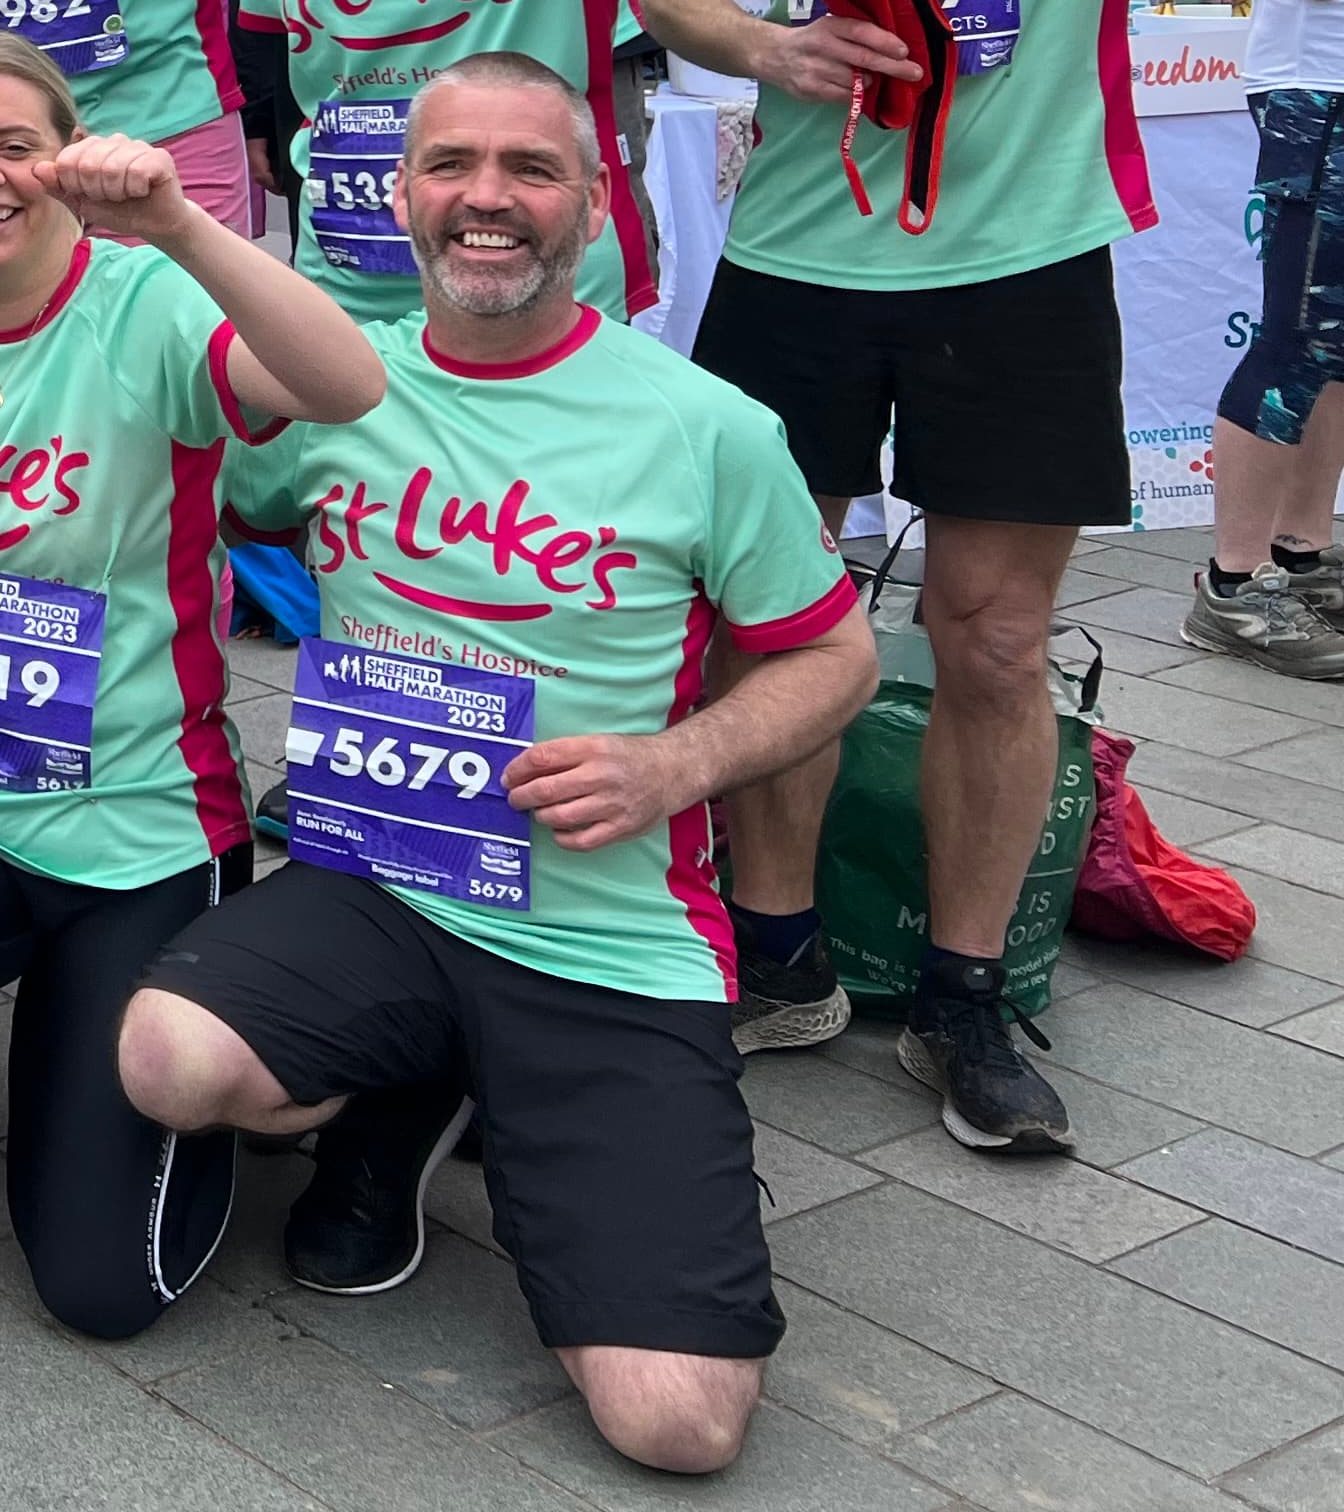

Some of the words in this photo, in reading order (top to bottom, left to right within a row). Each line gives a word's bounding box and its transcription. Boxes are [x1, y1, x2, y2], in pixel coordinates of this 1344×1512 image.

[340, 107, 392, 121] SHEFFIELD
[368, 120, 406, 134] MARA
[1151, 480, 1214, 500] human
[313, 481, 389, 574] St
[394, 466, 638, 612] Luke's
[23, 617, 79, 644] 2023
[340, 614, 454, 662] Sheffield's
[460, 637, 570, 682] Hospice
[366, 658, 441, 685] SHEFFIELD
[364, 672, 404, 694] HALF
[404, 680, 505, 713] MARATHON
[447, 705, 506, 733] 2023
[328, 727, 492, 801] 5679
[295, 816, 320, 832] RUN
[321, 823, 343, 837] FOR
[344, 829, 365, 842] ALL
[370, 863, 414, 882] Baggage
[414, 872, 440, 887] label
[468, 878, 523, 903] 5679
[829, 936, 857, 957] This
[862, 949, 888, 972] bag
